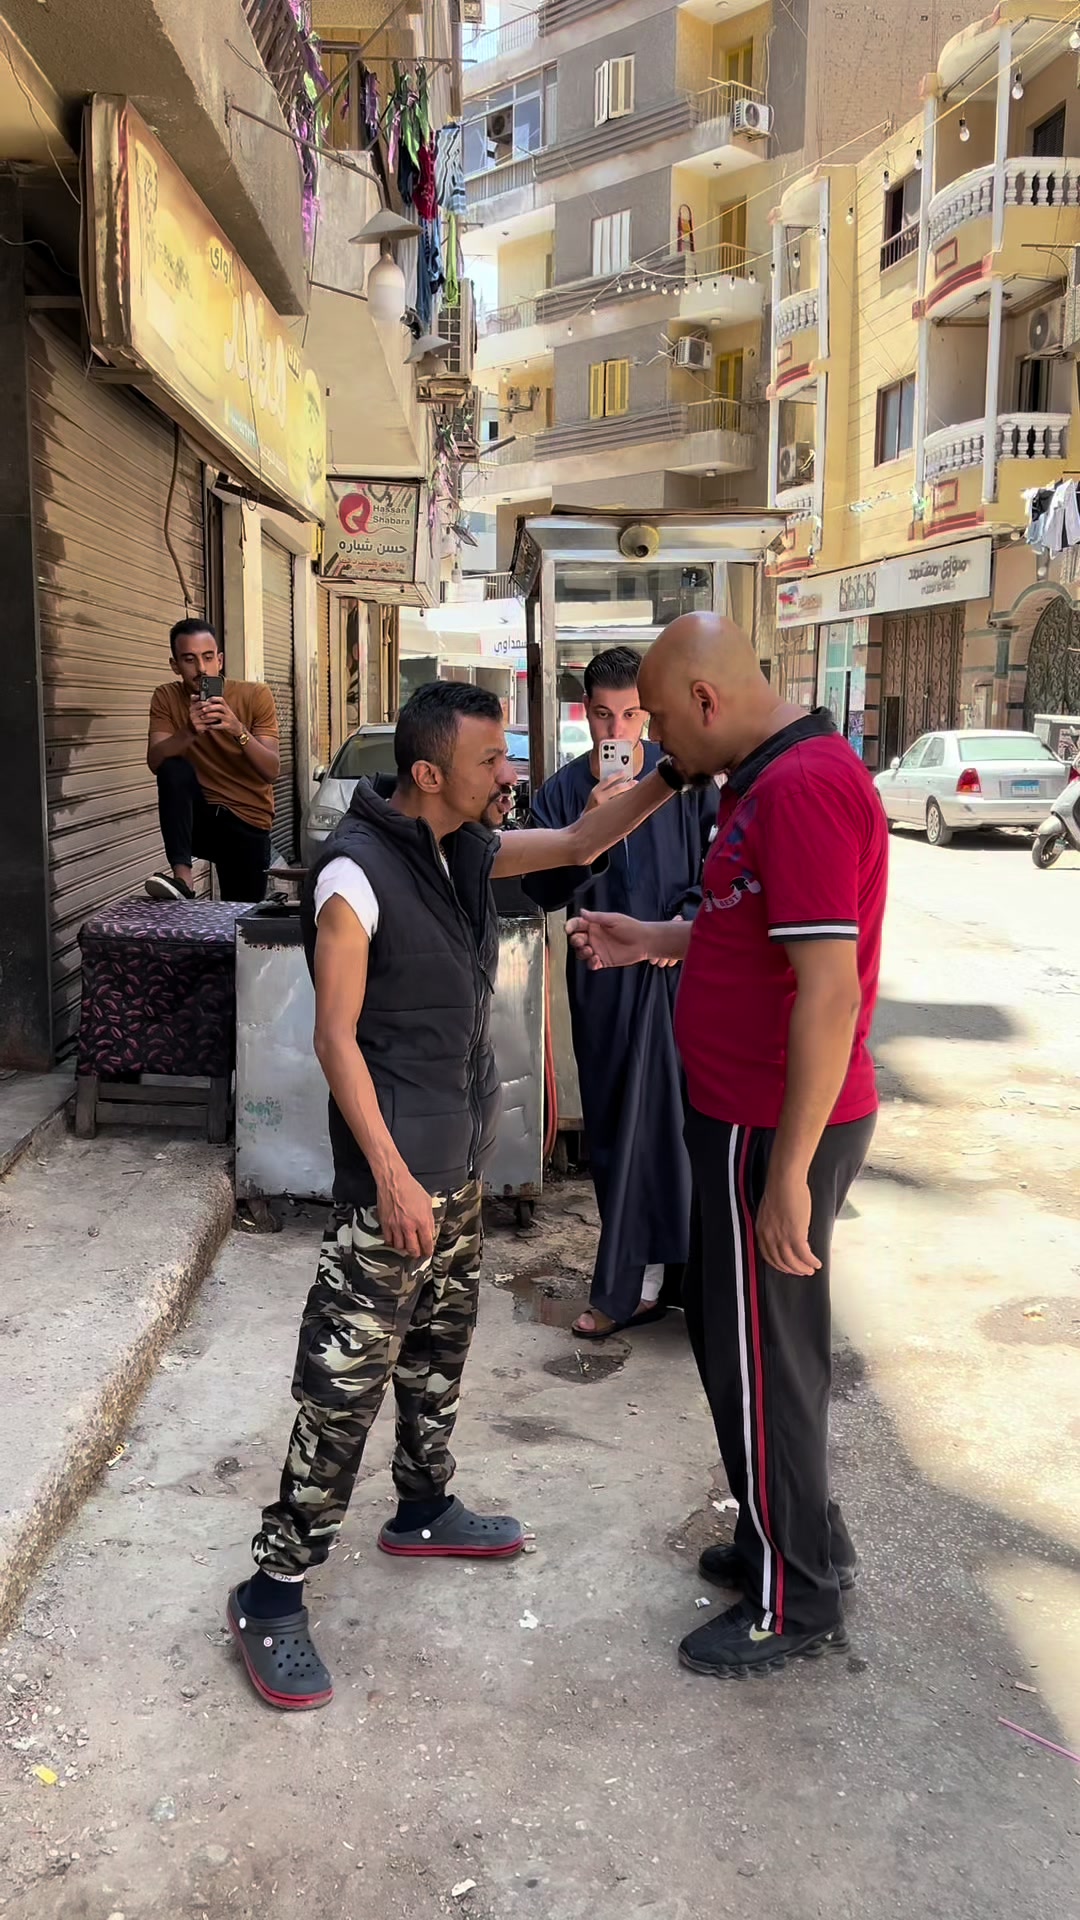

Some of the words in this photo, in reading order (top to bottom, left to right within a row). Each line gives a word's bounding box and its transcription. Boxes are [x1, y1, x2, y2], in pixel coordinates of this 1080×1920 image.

[373, 505, 407, 514] Hassan
[373, 515, 410, 525] Shabara
[339, 538, 373, 554] شباره
[376, 543, 407, 555] حسن
[908, 561, 939, 580] معتمد
[941, 556, 968, 580] موزع
[720, 894, 739, 907] BEST
